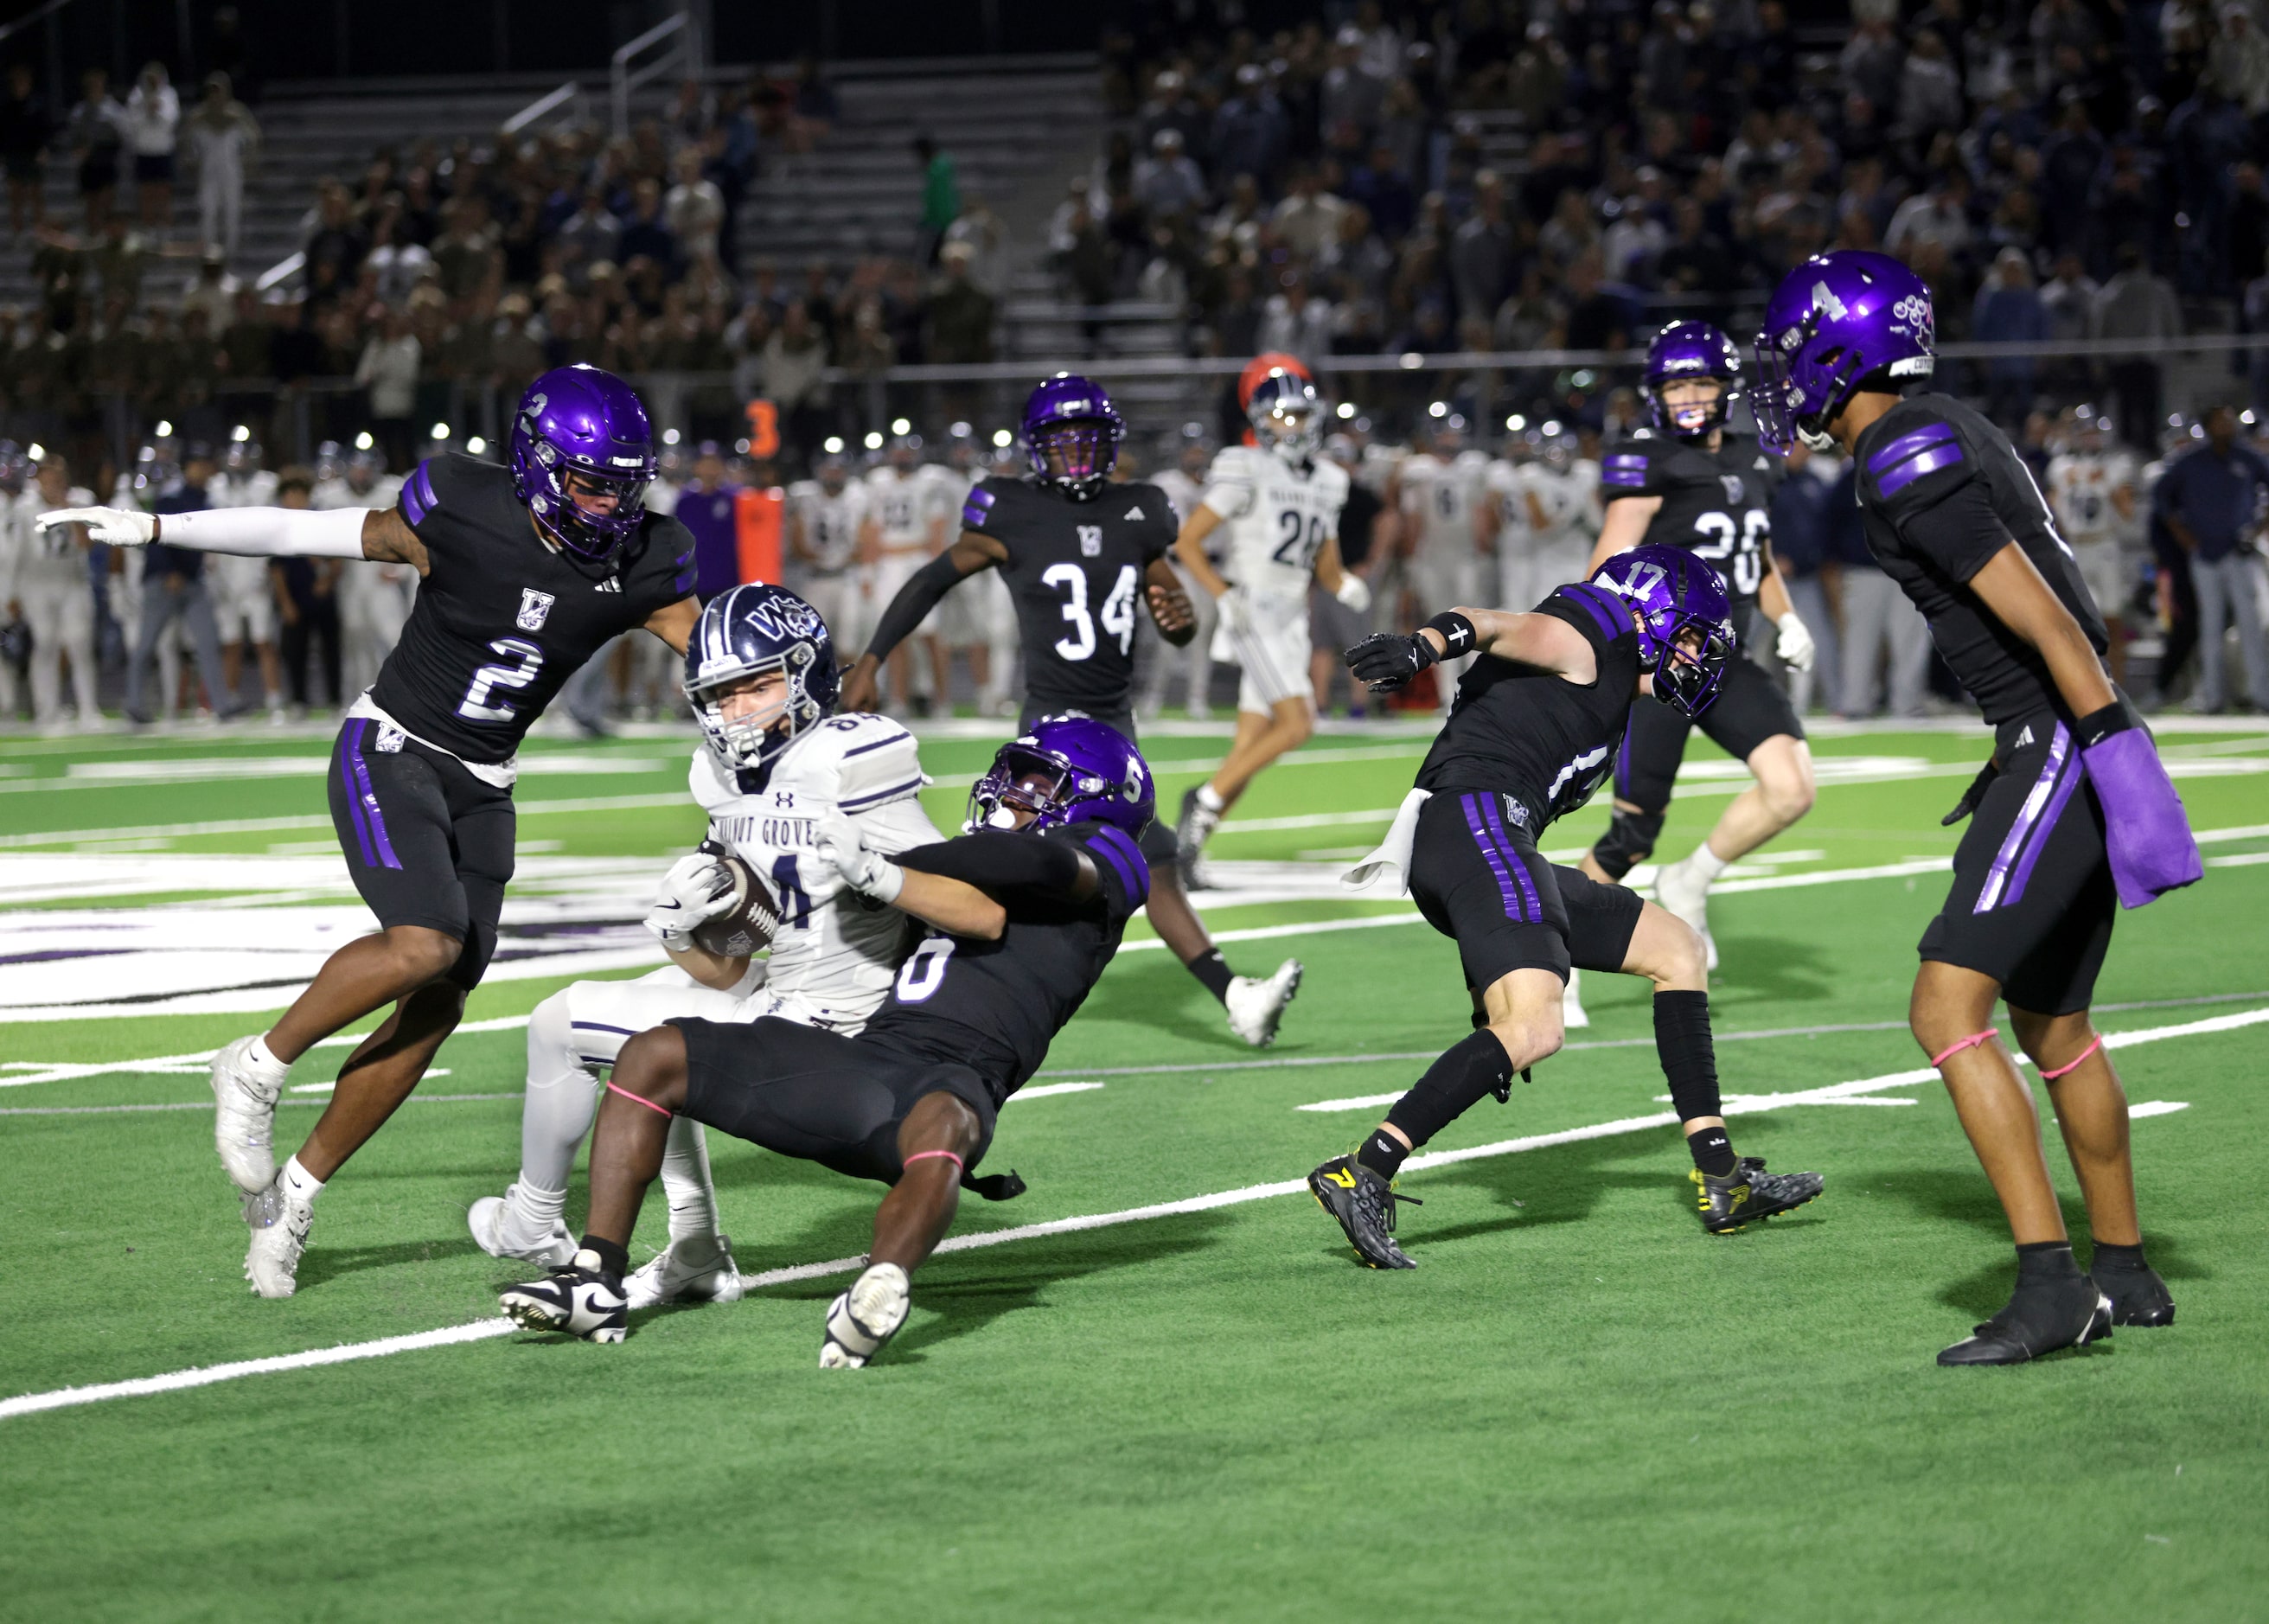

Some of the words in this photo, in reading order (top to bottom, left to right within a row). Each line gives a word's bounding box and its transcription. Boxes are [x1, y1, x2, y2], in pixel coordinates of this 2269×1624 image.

[1812, 279, 1849, 323] 4
[744, 398, 779, 460] 3
[1624, 559, 1669, 603] 17
[1040, 562, 1139, 662] 34
[454, 636, 546, 723] 2
[762, 818, 814, 846] GROVE
